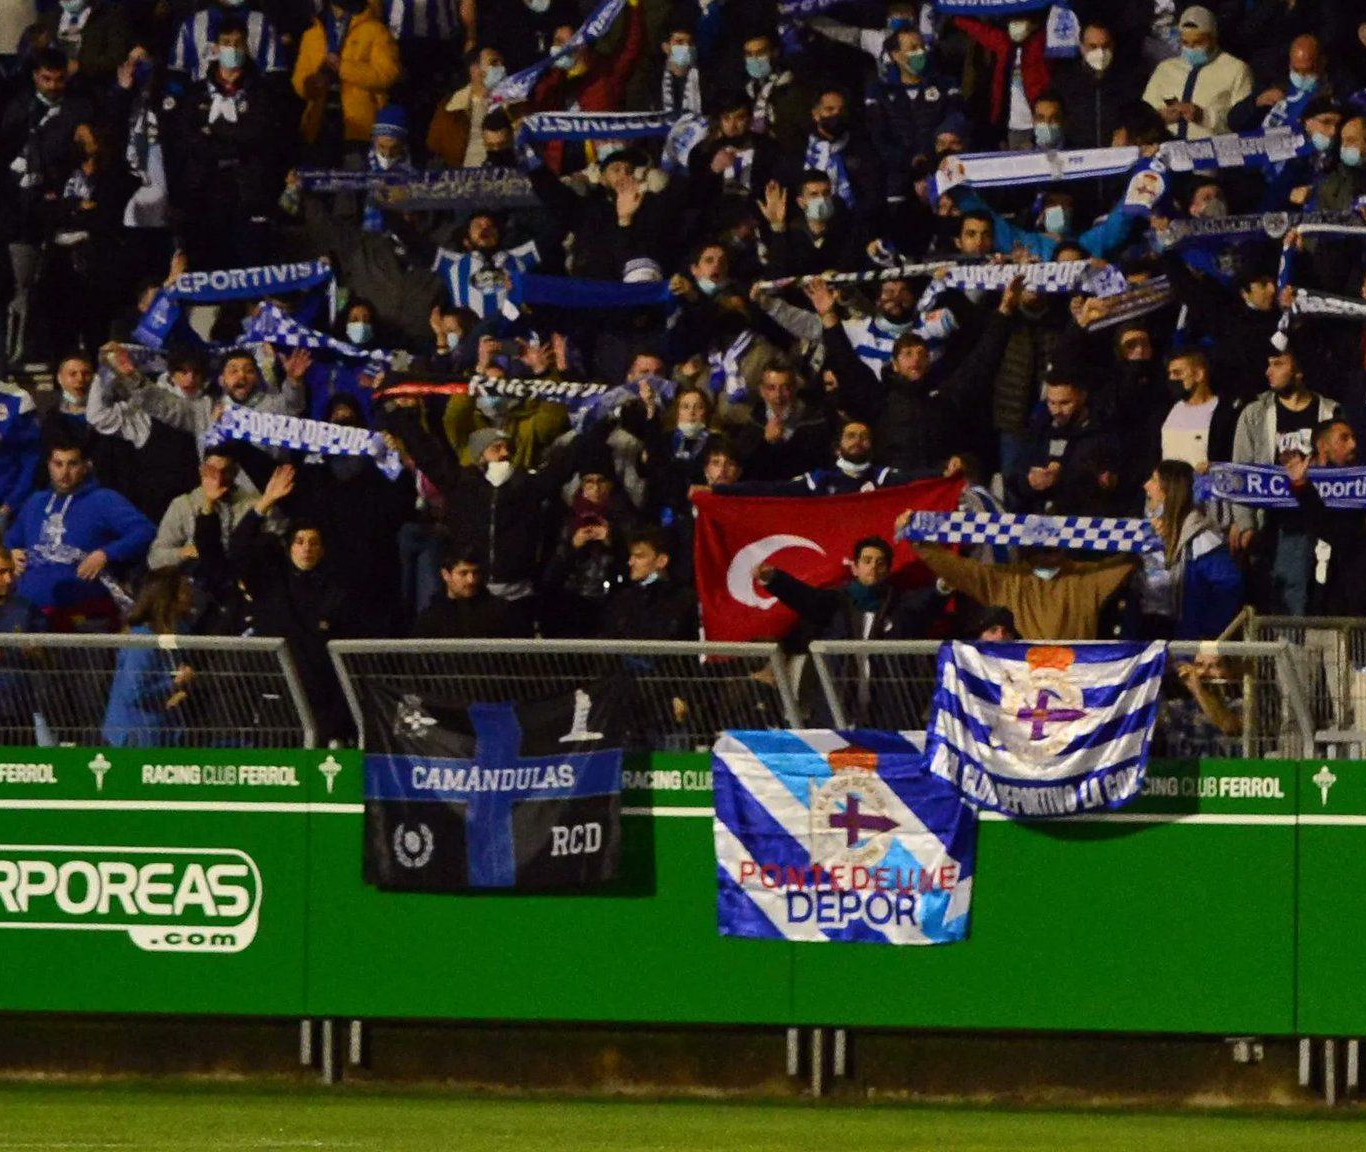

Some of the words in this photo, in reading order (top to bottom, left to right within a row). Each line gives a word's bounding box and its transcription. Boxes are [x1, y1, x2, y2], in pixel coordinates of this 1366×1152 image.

[142, 764, 200, 784] RACING
[238, 765, 300, 786] FERROL
[1219, 776, 1284, 799] FERROL
[550, 821, 602, 857] RCD
[785, 890, 917, 927] DEPOR
[150, 931, 237, 946] .com
